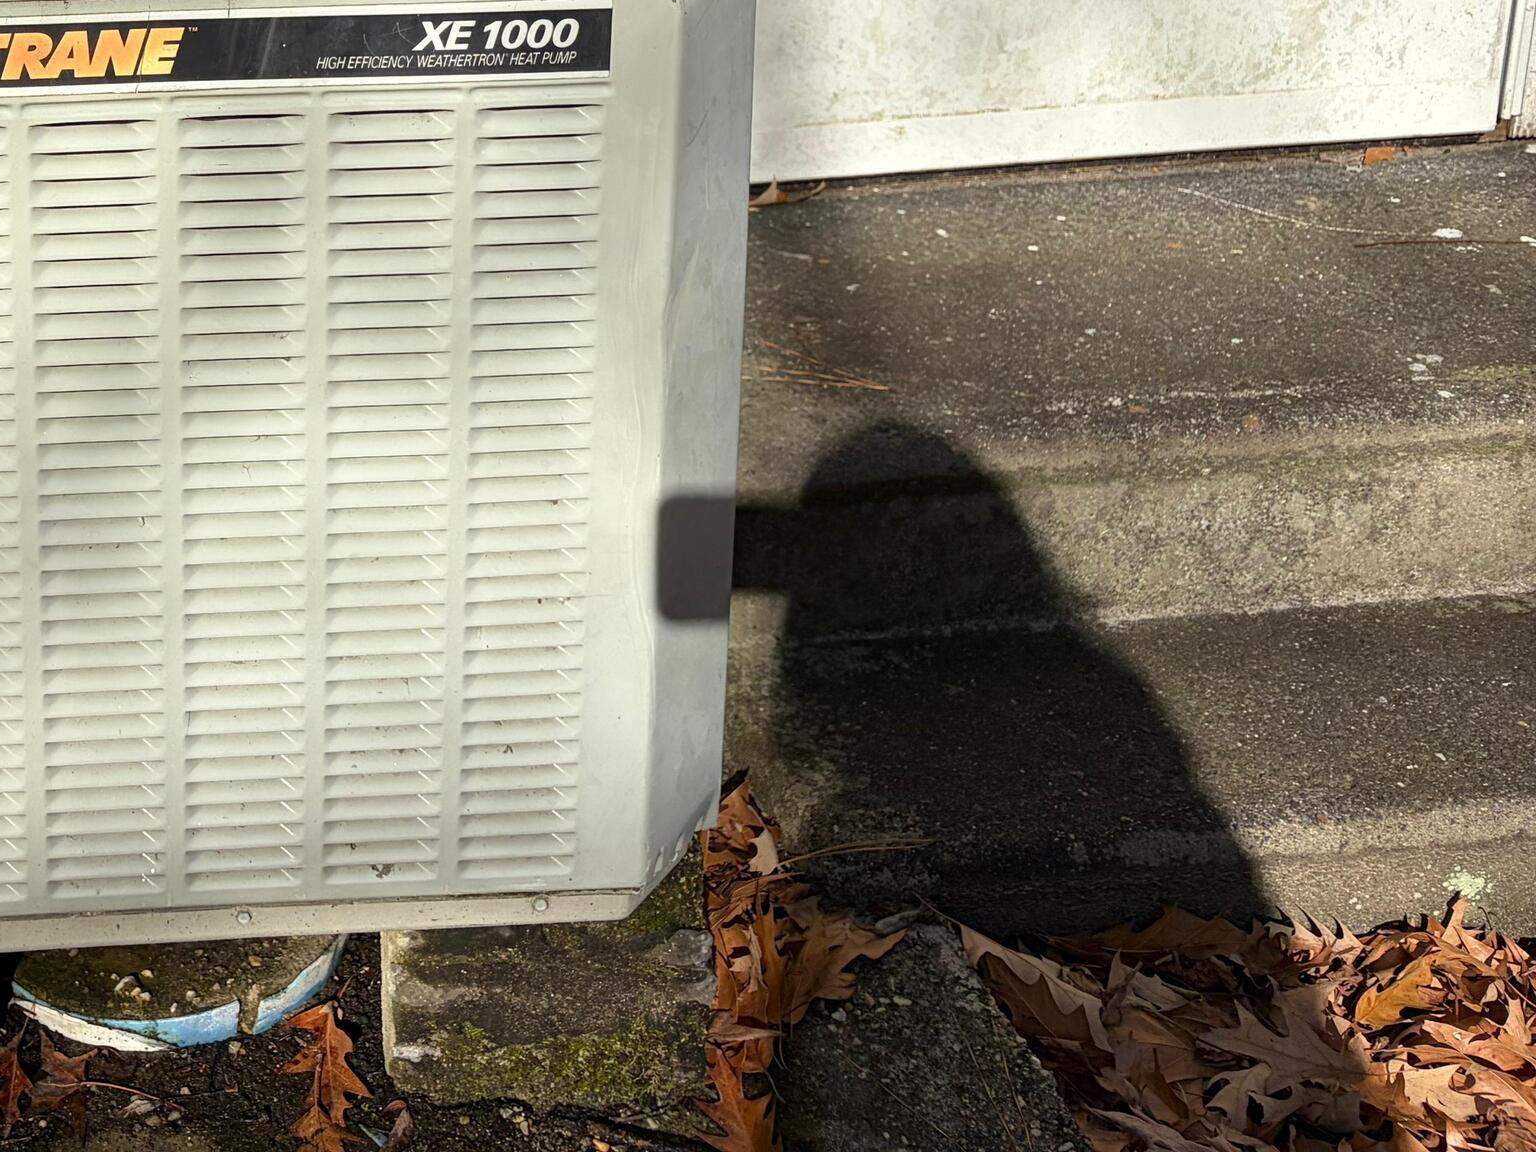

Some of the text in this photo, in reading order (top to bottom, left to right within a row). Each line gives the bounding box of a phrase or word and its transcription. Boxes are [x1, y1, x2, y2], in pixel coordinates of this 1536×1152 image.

[412, 18, 580, 52] XE 1000
[316, 51, 577, 70] HIGH EFFICIENCY WEATHERTRON HEAT PUMP
